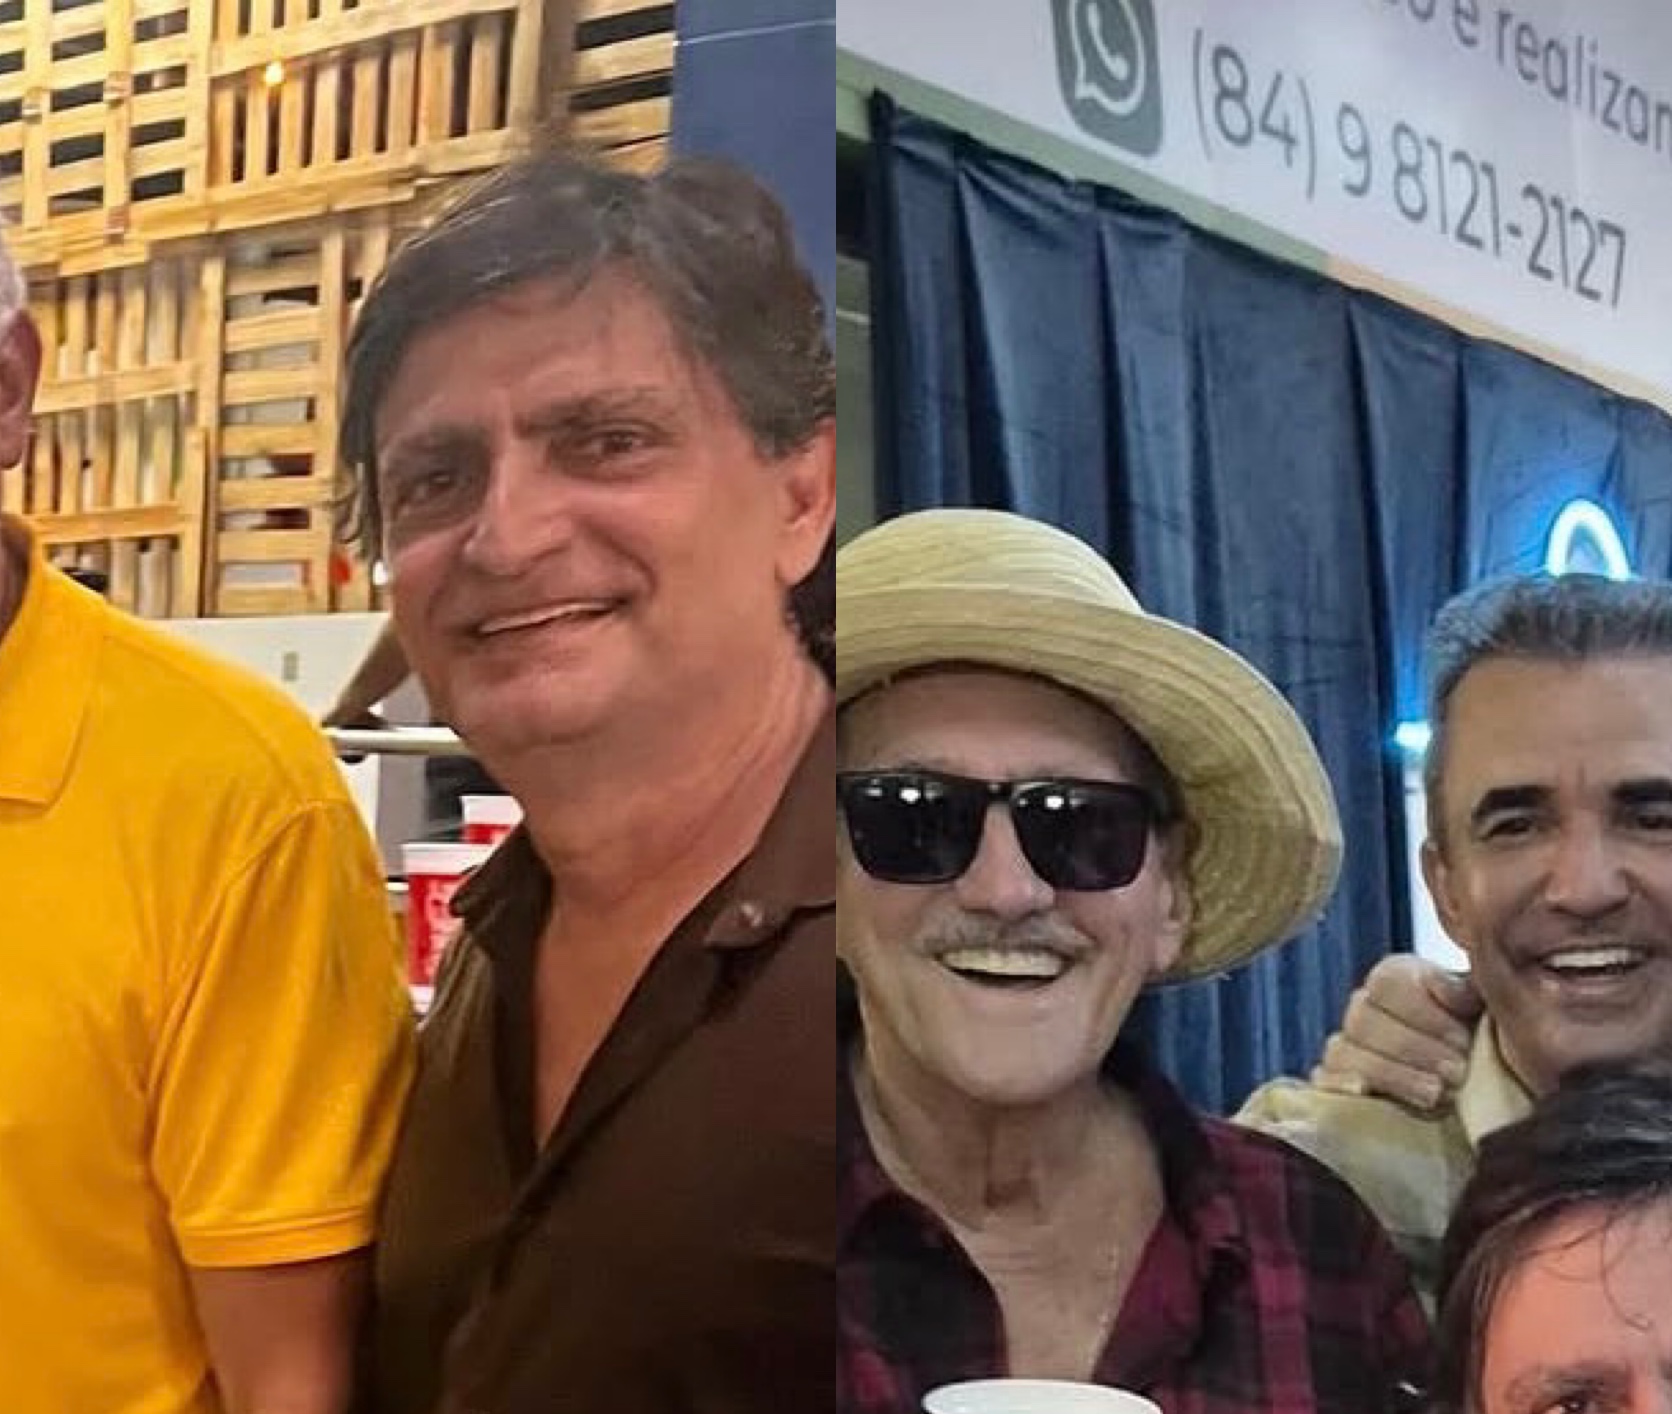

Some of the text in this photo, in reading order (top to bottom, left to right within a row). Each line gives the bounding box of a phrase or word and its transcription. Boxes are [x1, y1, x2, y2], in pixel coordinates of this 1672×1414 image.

[1453, 0, 1481, 49] e
[1192, 28, 1626, 308] (84) 9 8121-2127
